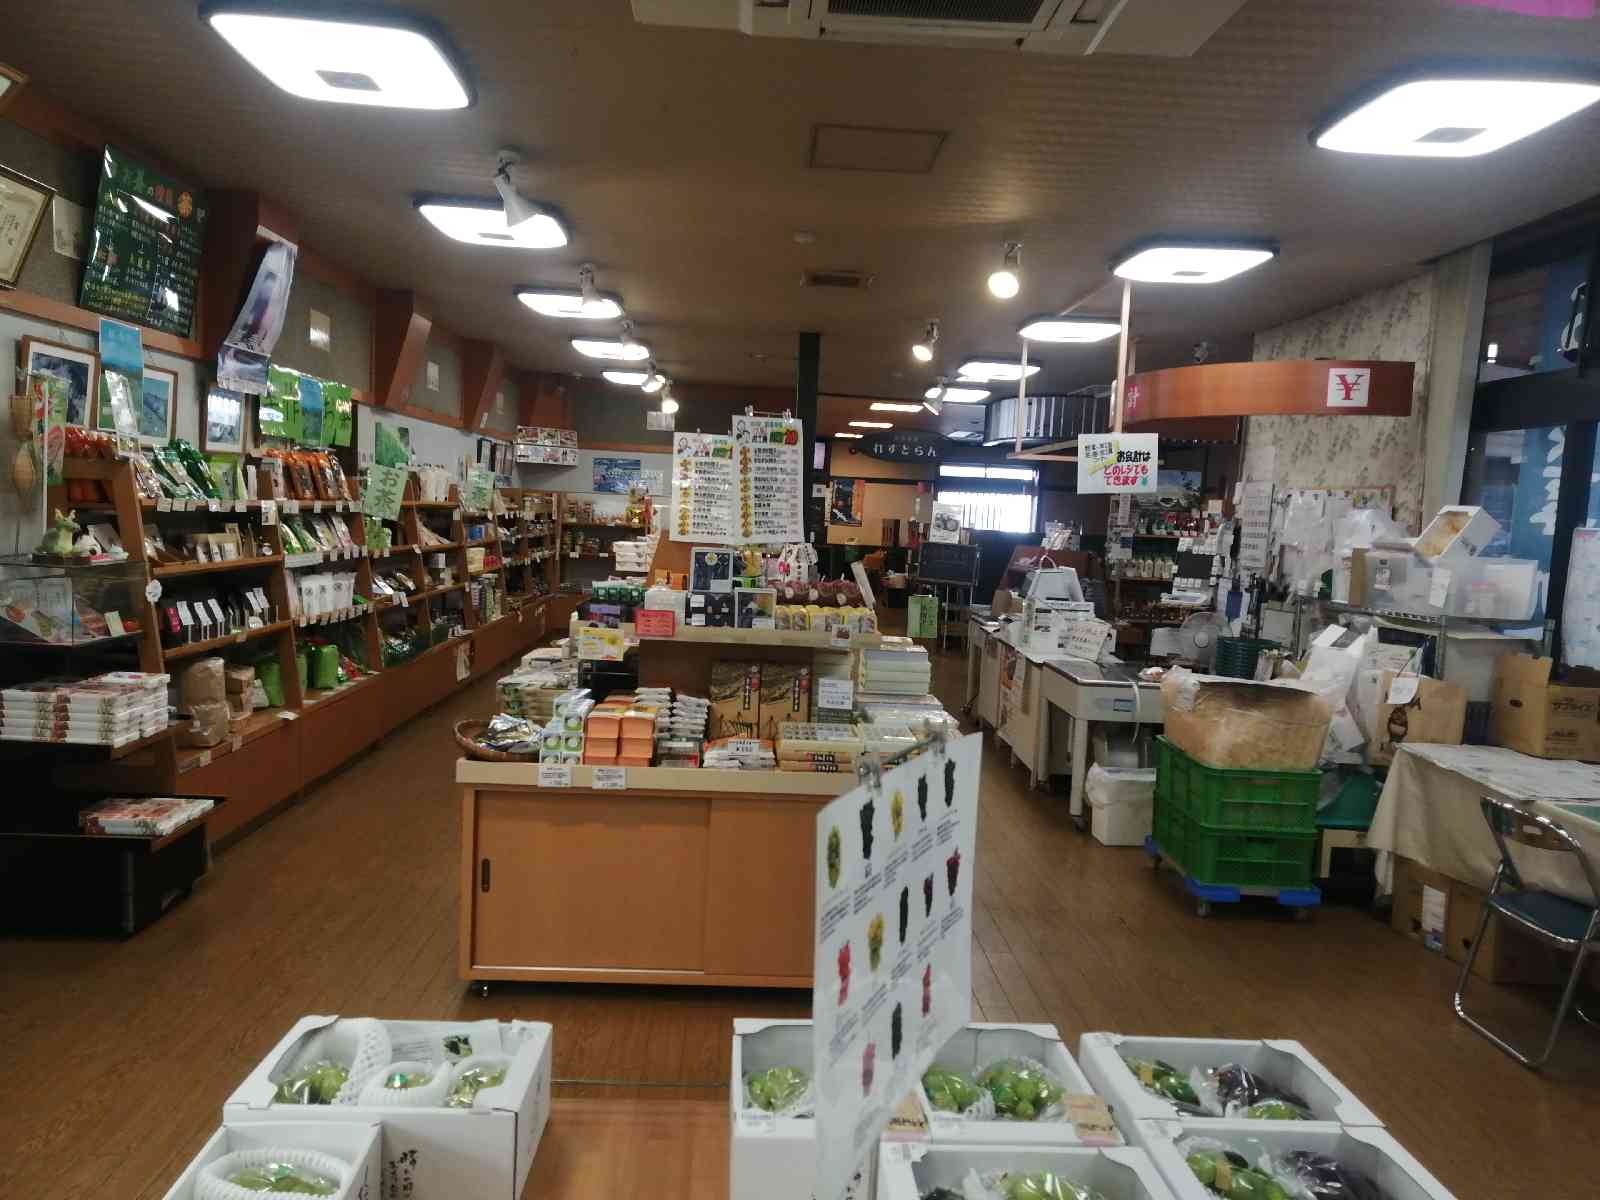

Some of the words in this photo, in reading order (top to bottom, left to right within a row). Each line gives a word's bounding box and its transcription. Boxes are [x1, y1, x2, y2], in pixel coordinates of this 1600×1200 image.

[873, 441, 936, 457] れすとらん
[374, 470, 401, 511] お茶
